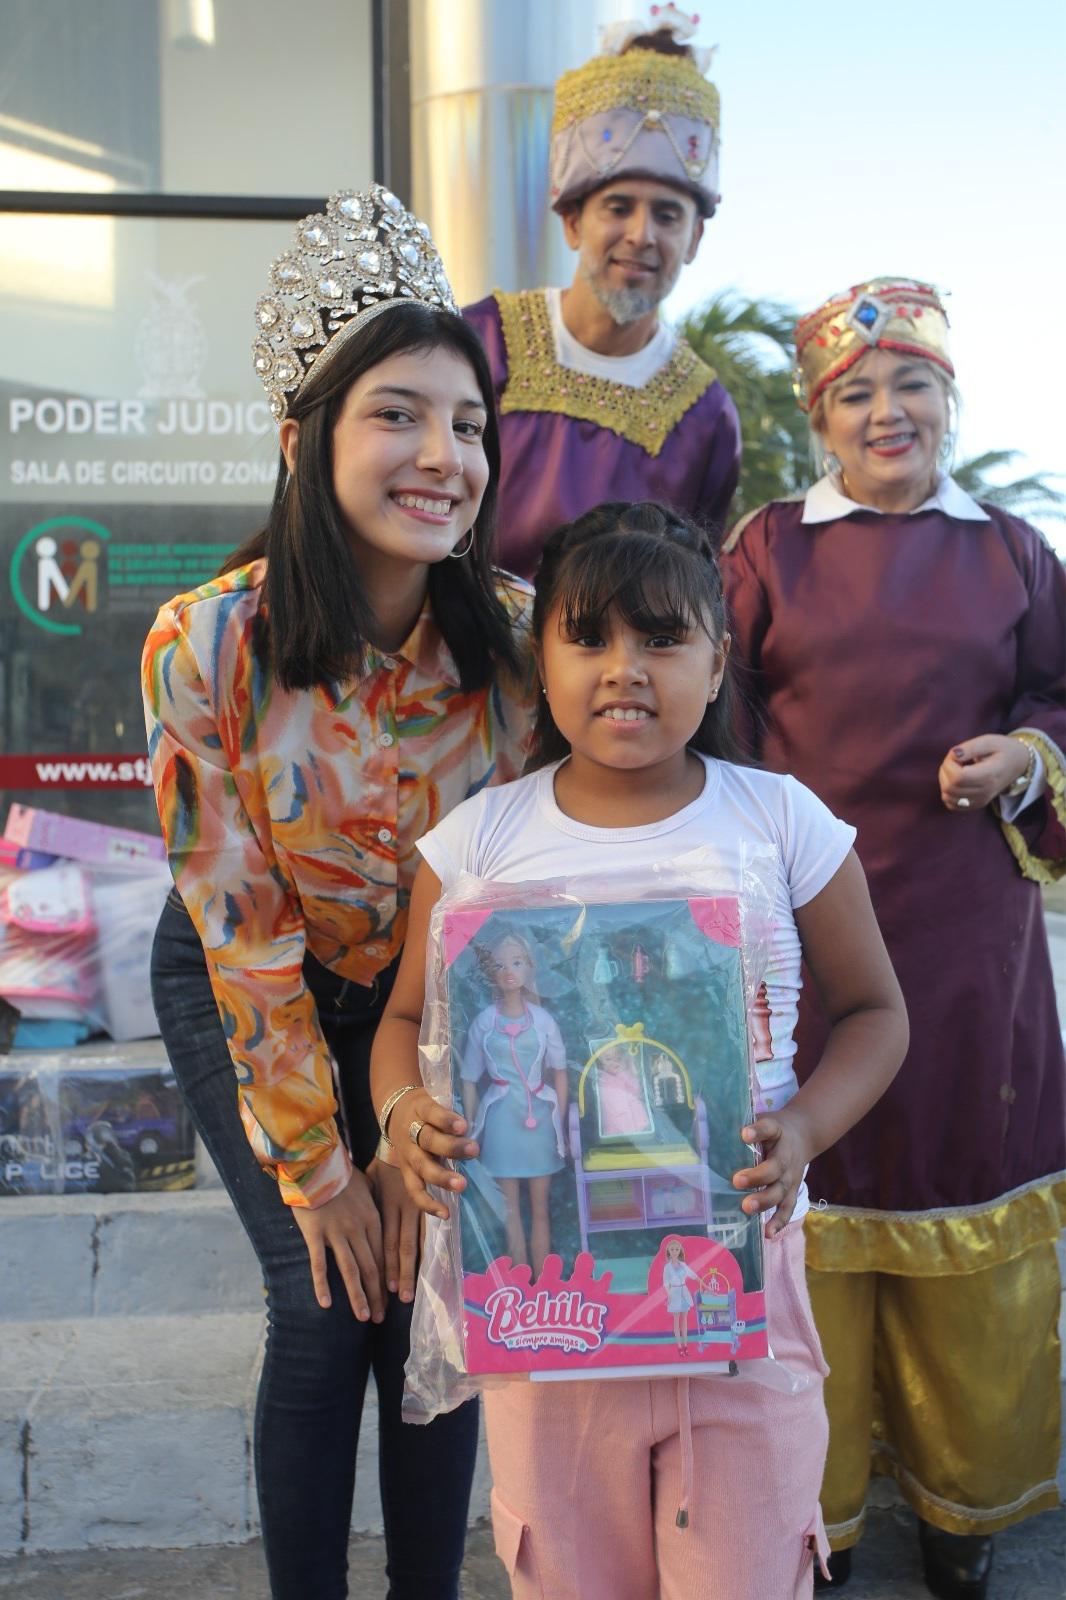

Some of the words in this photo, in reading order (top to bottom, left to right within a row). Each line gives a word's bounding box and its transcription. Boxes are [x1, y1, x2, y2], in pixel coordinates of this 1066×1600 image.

[9, 398, 147, 434] PODER
[157, 400, 279, 434] JUDIC
[10, 459, 70, 485] SALA
[76, 460, 106, 485] DE
[111, 460, 217, 485] CIRCUITO
[515, 1336, 548, 1349] siempre
[549, 1336, 579, 1350] amigas
